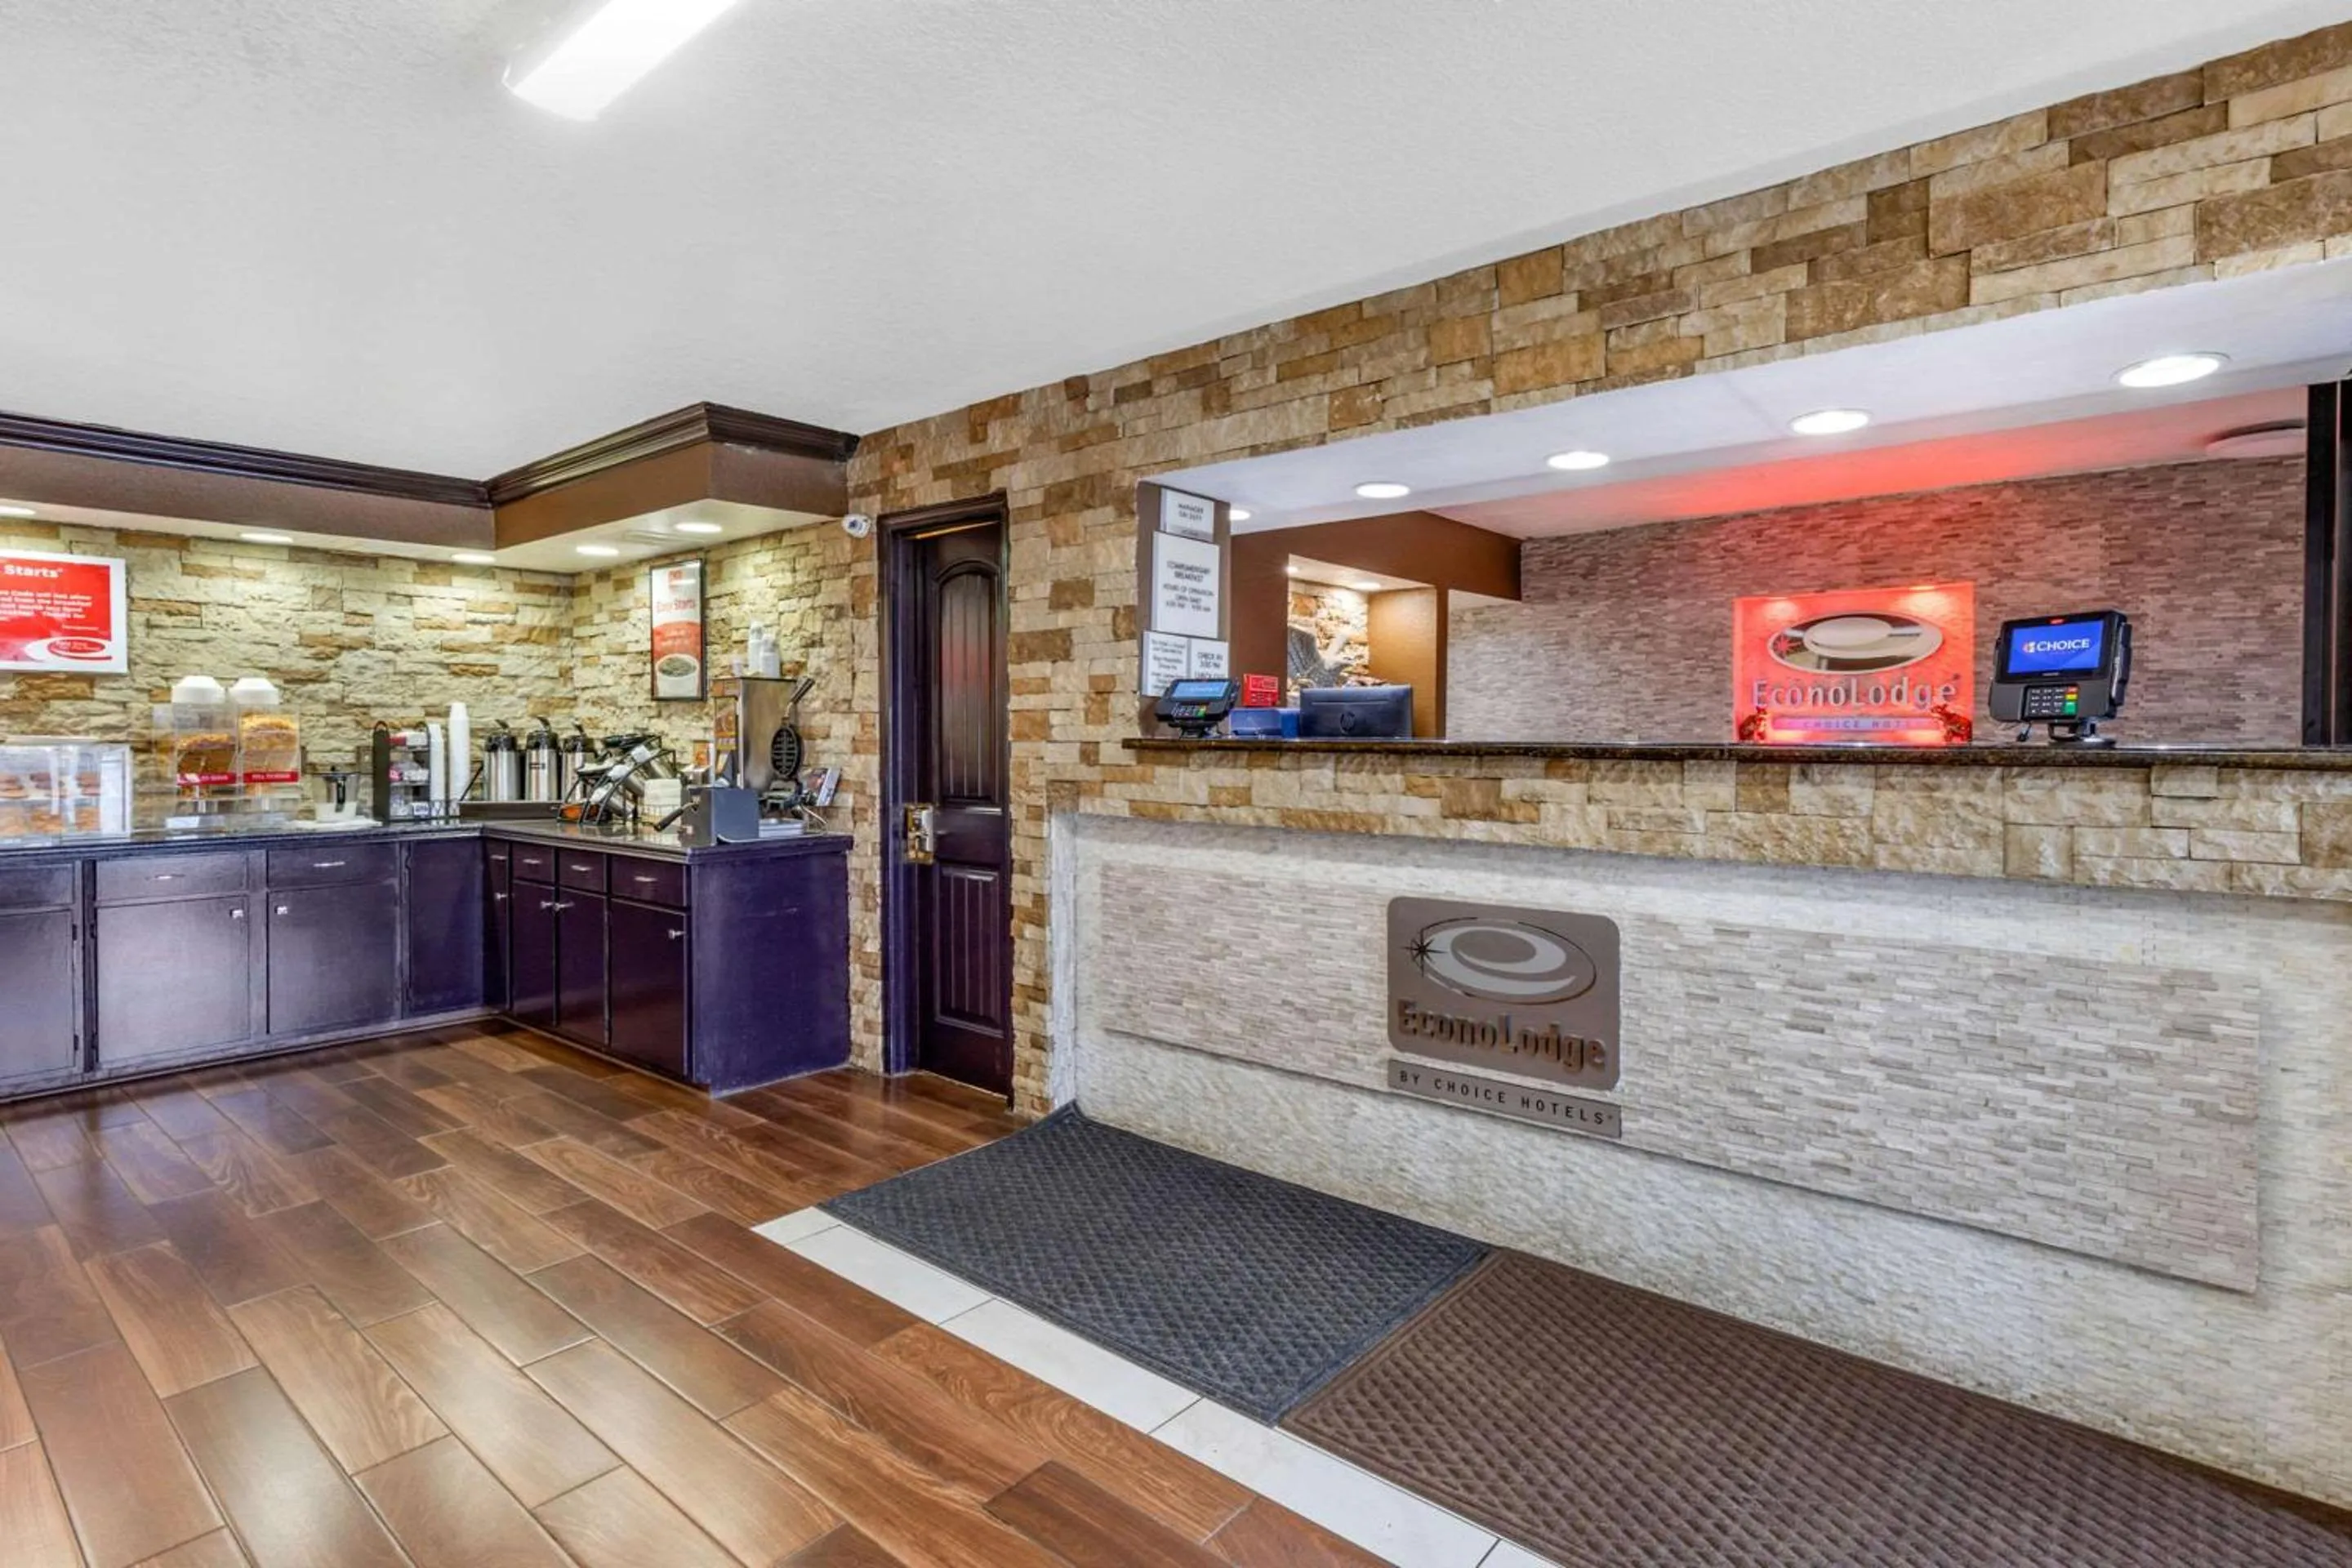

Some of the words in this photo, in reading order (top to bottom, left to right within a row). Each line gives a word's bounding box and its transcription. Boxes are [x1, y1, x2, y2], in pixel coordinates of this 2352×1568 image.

[4, 564, 60, 578] Starts
[2037, 639, 2091, 652] CHOICE
[1752, 676, 1957, 710] EconoLodge
[1802, 719, 1860, 729] CHOICE
[1397, 998, 1606, 1073] EconoLodge
[1399, 1069, 1420, 1085] BY
[1434, 1078, 1507, 1104] CHOICE
[1521, 1097, 1605, 1125] HOTELS
